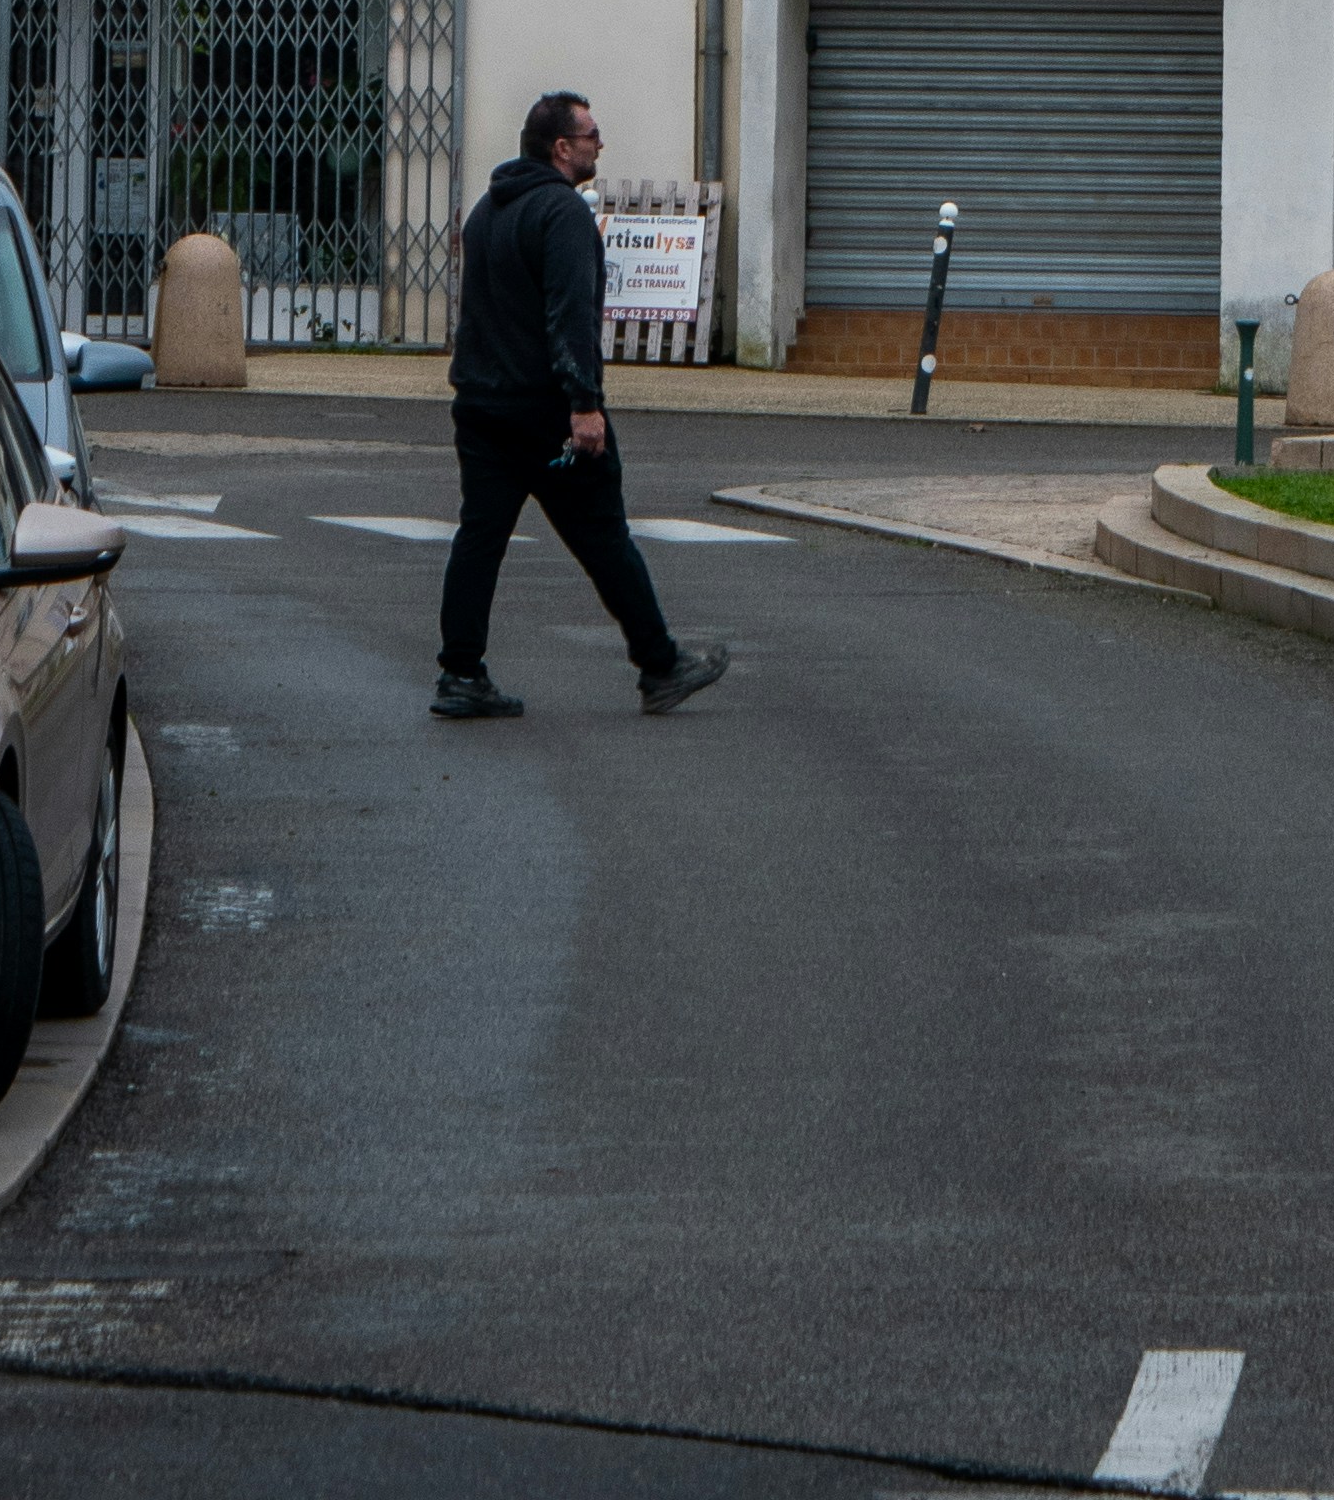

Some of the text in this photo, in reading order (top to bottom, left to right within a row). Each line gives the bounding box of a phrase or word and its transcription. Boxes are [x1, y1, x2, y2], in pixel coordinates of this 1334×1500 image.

[656, 217, 697, 225] Construction
[643, 263, 680, 275] RÉALISÉ
[626, 279, 686, 289] CES TRAVAUX
[611, 308, 626, 319] 06
[627, 309, 642, 319] 42
[644, 310, 658, 320] 12
[676, 310, 691, 320] 99
